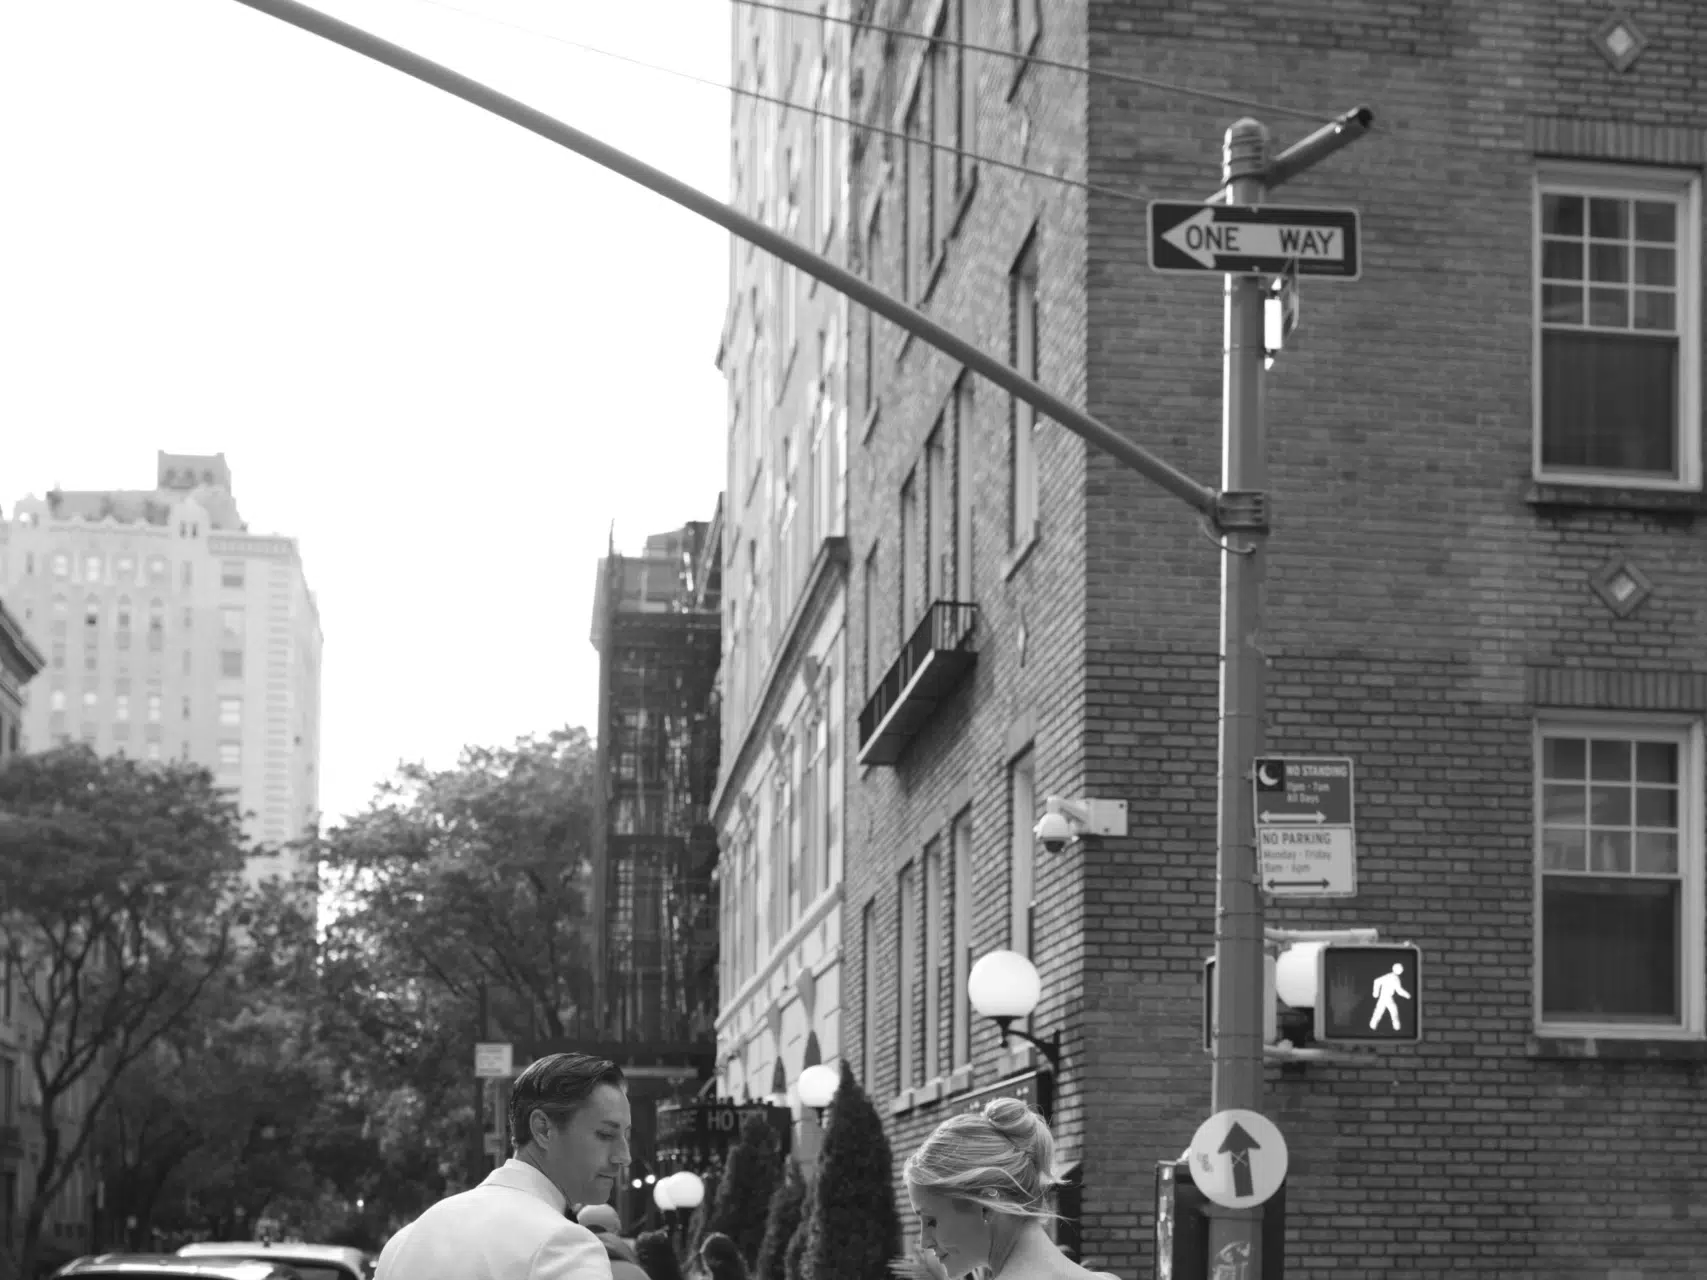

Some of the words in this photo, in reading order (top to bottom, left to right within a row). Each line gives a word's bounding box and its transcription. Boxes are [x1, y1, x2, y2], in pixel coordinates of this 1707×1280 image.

[1185, 224, 1240, 252] ONE
[1279, 227, 1335, 255] WAY
[1286, 765, 1301, 777] NO
[1302, 765, 1348, 778] STANDING
[1300, 793, 1320, 806] Days
[1263, 832, 1277, 845] NO
[1282, 832, 1332, 845] PARKING
[1264, 850, 1297, 863] Monday
[1305, 850, 1332, 863] Friday
